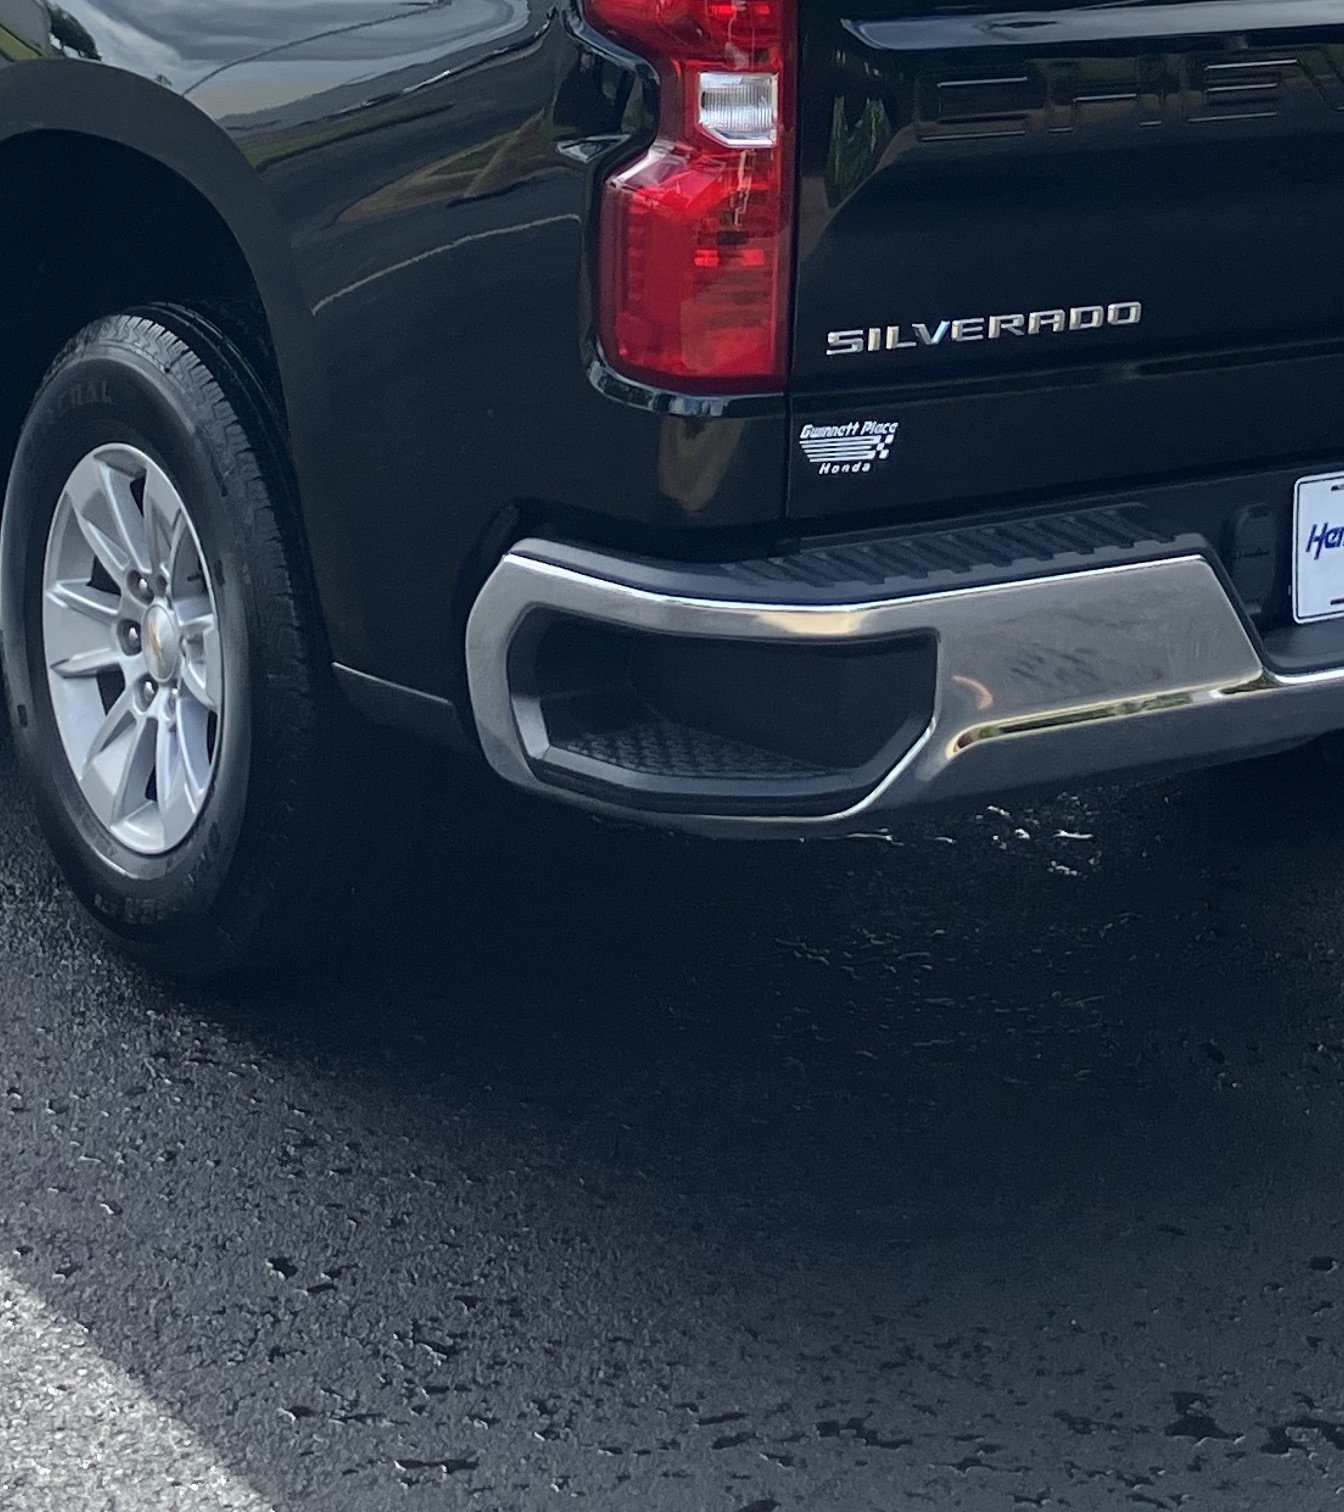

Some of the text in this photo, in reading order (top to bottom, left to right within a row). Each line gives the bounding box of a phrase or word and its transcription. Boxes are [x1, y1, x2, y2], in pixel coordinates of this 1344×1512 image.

[826, 301, 1142, 355] SILVERADO
[799, 420, 899, 439] Gwinnett Place
[818, 462, 871, 475] Honda
